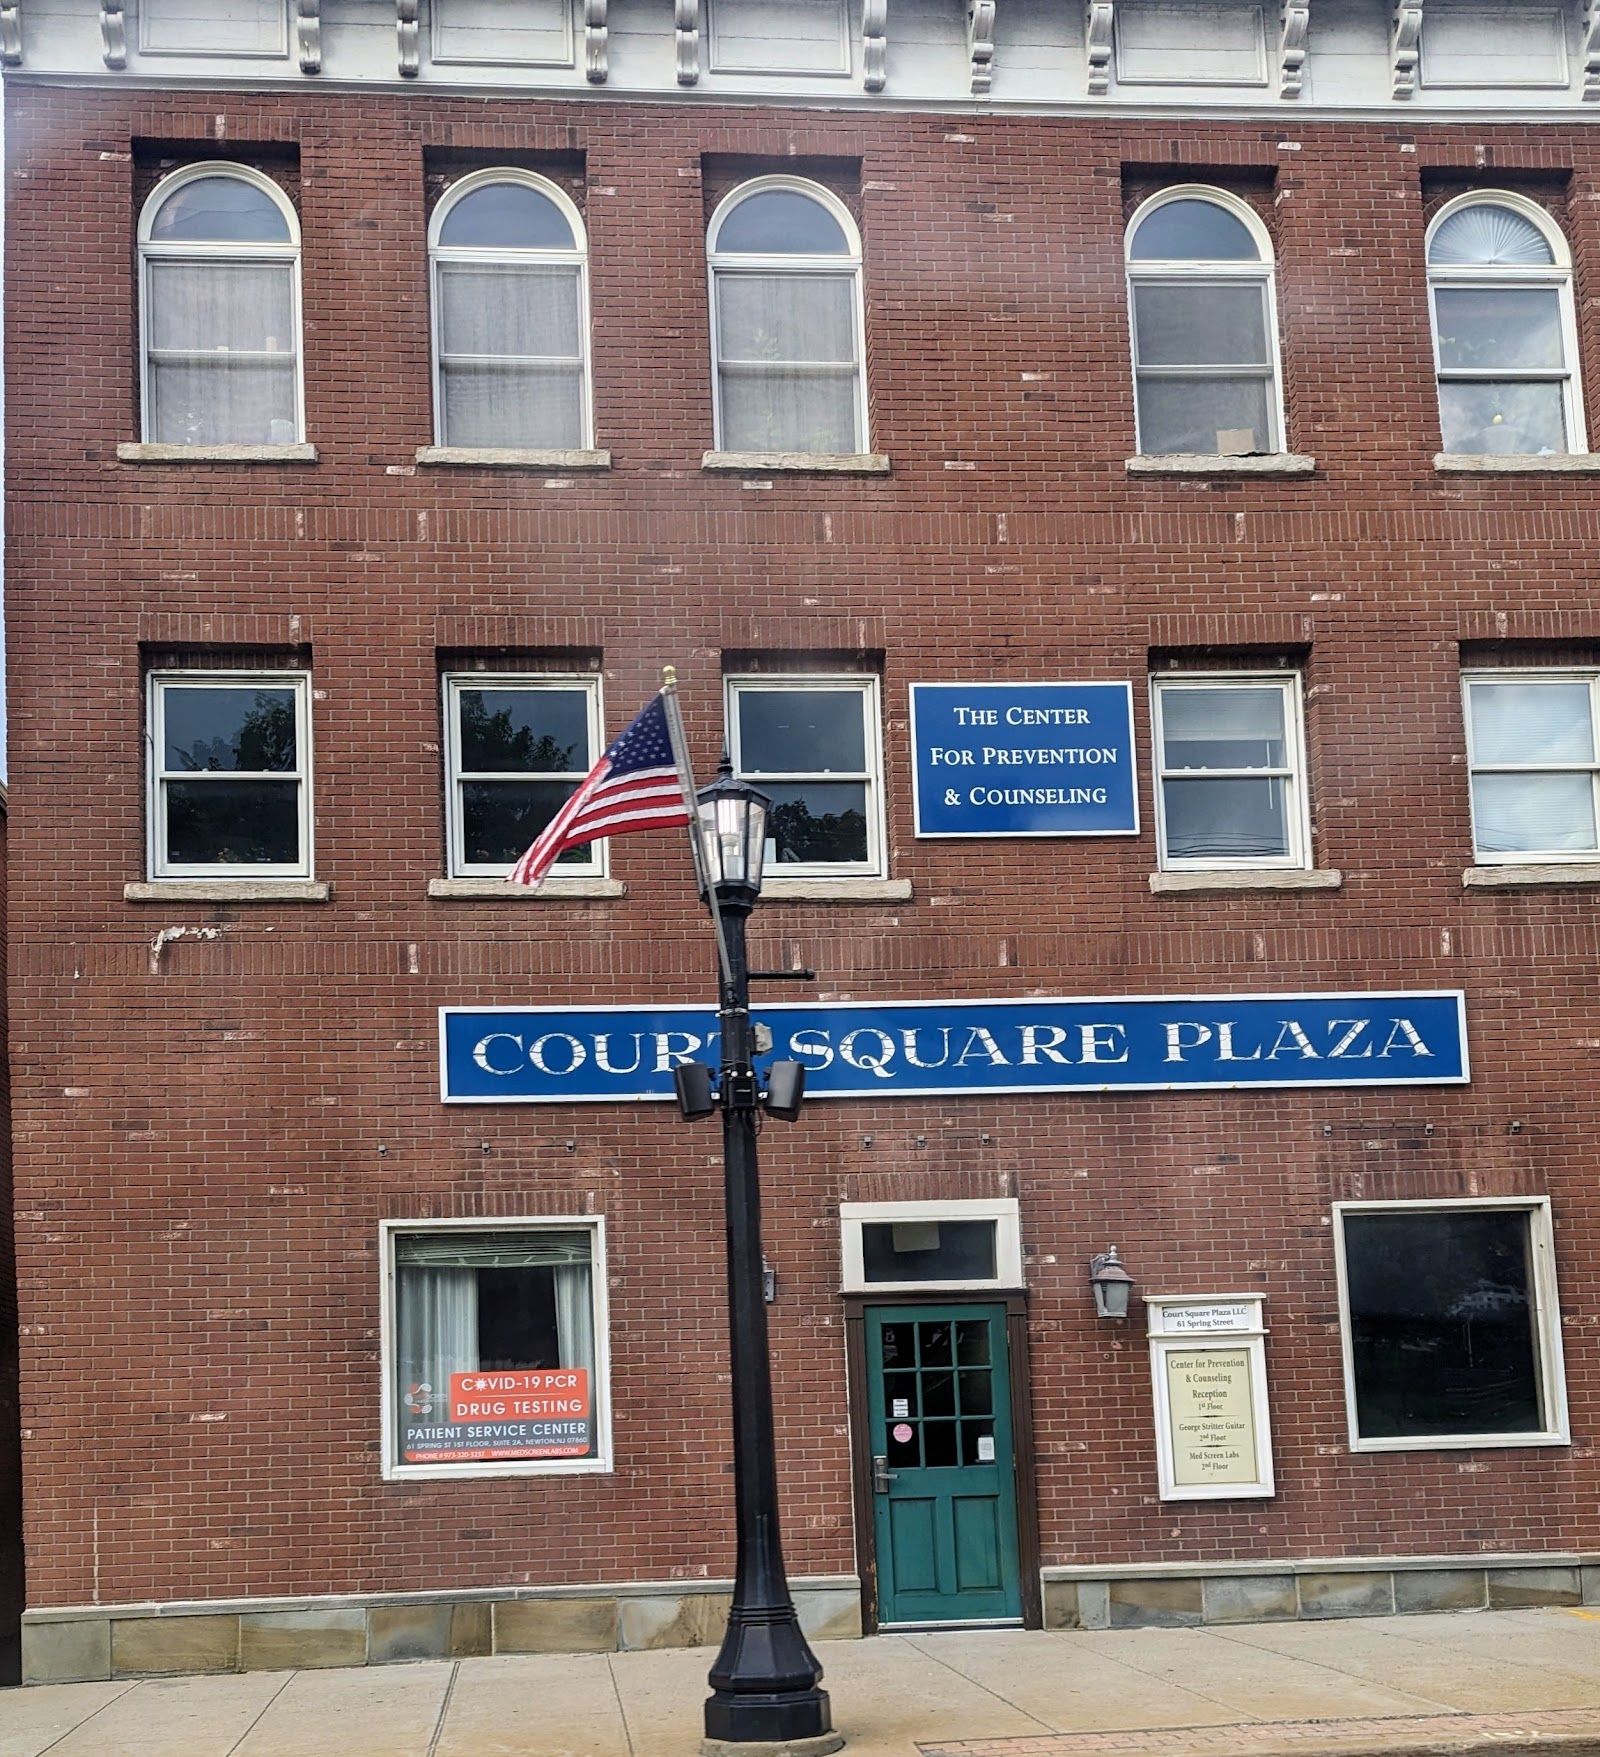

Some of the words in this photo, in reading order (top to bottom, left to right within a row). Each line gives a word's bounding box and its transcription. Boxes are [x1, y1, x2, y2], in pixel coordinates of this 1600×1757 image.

[953, 706, 999, 726] THE
[1005, 706, 1091, 725] CENTER
[930, 747, 976, 766] FOR
[982, 747, 1118, 765] PREVENTION
[944, 788, 962, 806] &
[969, 786, 1108, 806] COUNSELING
[472, 1030, 722, 1076] COUR
[788, 1023, 1130, 1079] SQUARE
[1159, 1017, 1436, 1064] PLAZA
[1162, 1310, 1184, 1318] Court
[1184, 1309, 1211, 1319] Square
[1211, 1308, 1231, 1316] Plaza
[1232, 1307, 1247, 1315] LLC
[1176, 1320, 1186, 1328] 61
[1187, 1319, 1212, 1328] Spring
[1212, 1318, 1234, 1326] Street
[1170, 1359, 1194, 1369] Center
[1195, 1359, 1206, 1368] for
[1207, 1358, 1245, 1368] Prevention
[545, 1375, 577, 1388] PCR
[1185, 1374, 1192, 1383] &
[1192, 1373, 1232, 1384] Counseling
[1192, 1389, 1228, 1400] Reception
[456, 1402, 506, 1416] DRUG
[513, 1399, 583, 1414] TESTING
[1207, 1402, 1223, 1410] Floor
[407, 1427, 462, 1440] PATIENT
[467, 1424, 527, 1438] SERVICE
[532, 1422, 586, 1435] CENTER
[1178, 1423, 1201, 1432] George
[1225, 1421, 1246, 1430] Guitar
[1199, 1433, 1209, 1442] 2nd
[1210, 1433, 1227, 1441] Floor
[1189, 1452, 1203, 1460] Med
[1203, 1451, 1224, 1459] Screen
[1225, 1451, 1240, 1459] Labs
[1201, 1462, 1211, 1471] 2nd
[1212, 1462, 1229, 1470] Floor
